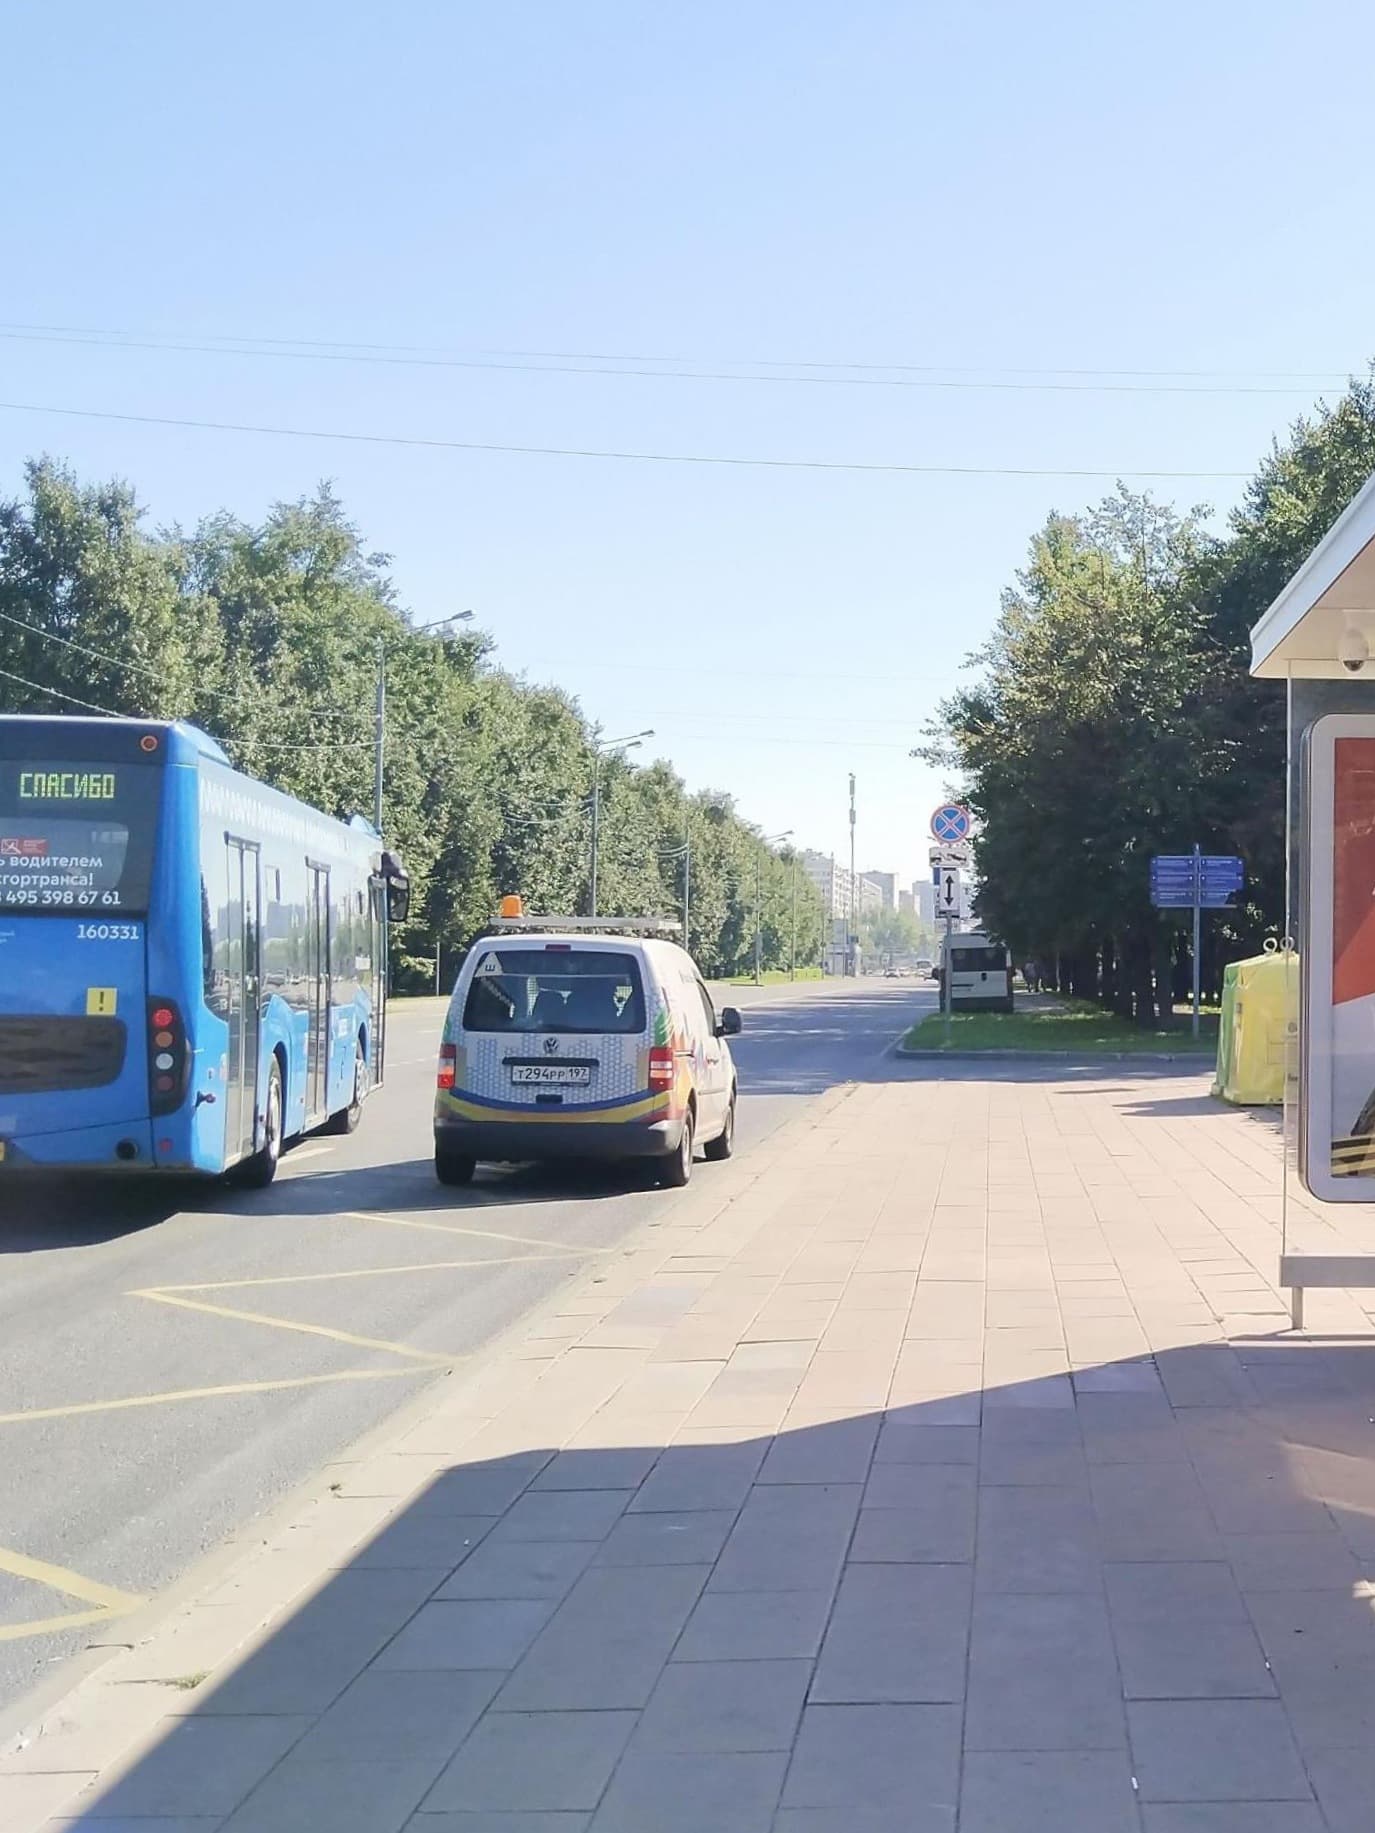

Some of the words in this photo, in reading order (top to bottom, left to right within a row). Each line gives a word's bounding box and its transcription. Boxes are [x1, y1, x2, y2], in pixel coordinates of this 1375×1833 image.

[19, 772, 115, 800] СПАСИБО
[10, 856, 103, 869] водителем
[6, 890, 38, 905] 495
[42, 890, 74, 905] 398
[78, 890, 98, 905] 67
[102, 890, 121, 905] 61
[77, 924, 139, 940] 160331
[568, 1068, 587, 1078] 197
